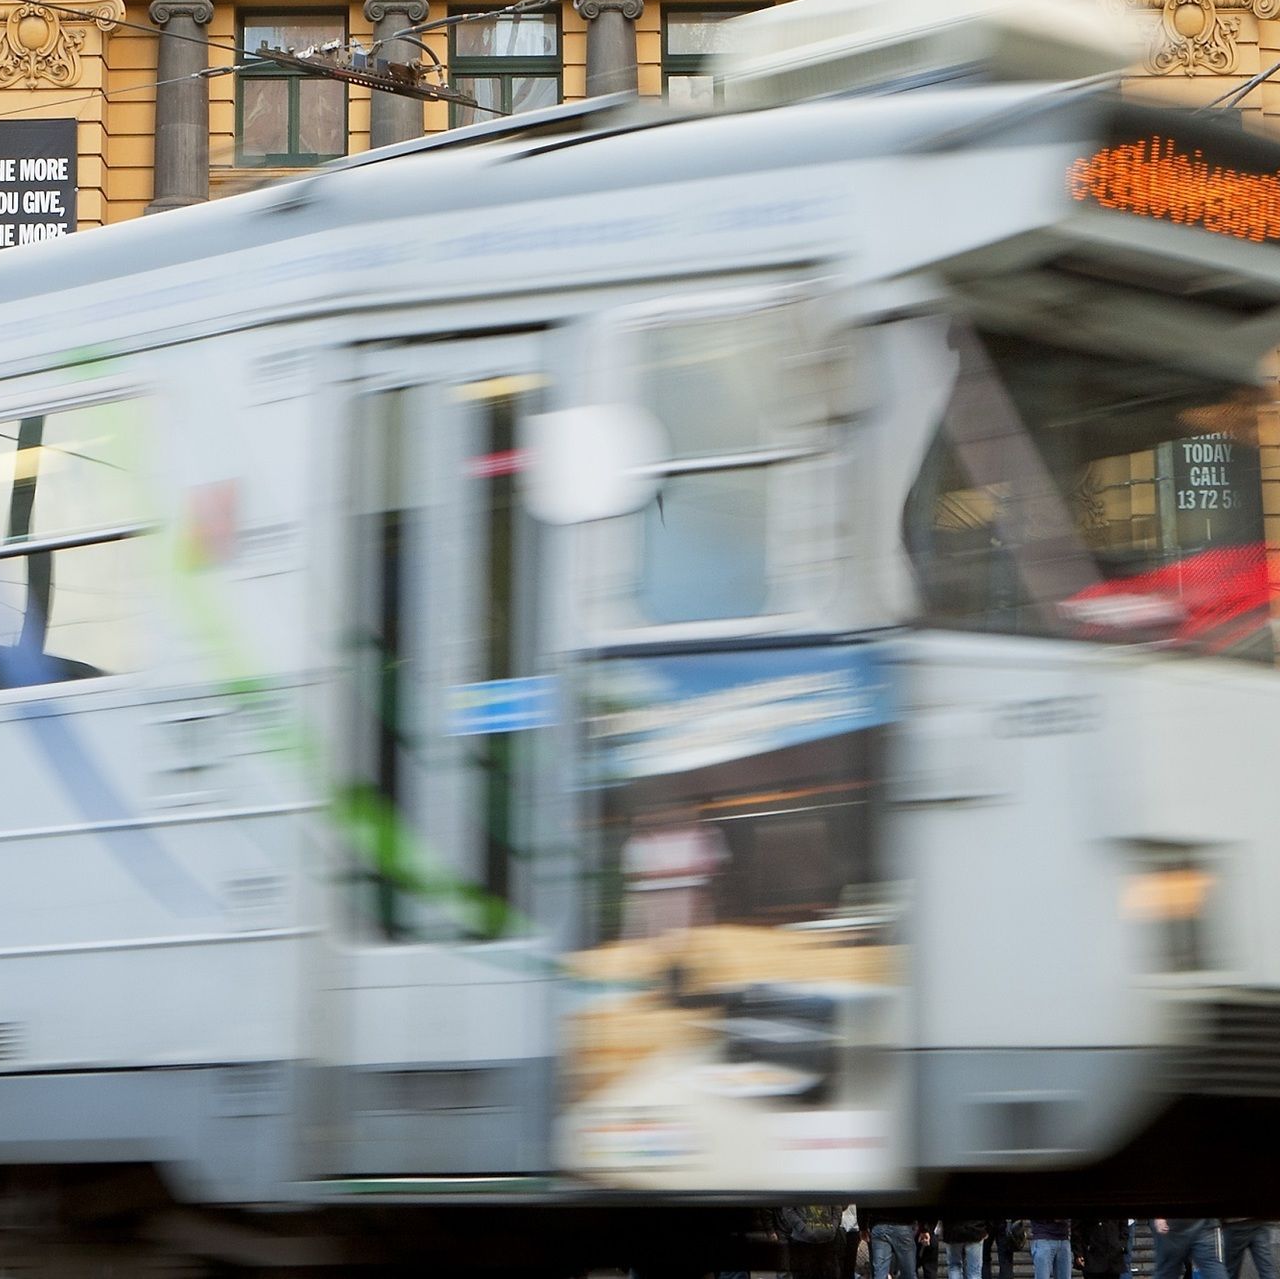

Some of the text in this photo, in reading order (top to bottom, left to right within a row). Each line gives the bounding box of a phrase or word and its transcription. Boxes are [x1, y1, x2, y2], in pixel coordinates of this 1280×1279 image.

[20, 158, 69, 182] MORE
[22, 190, 66, 217] GIVE,
[1190, 466, 1230, 487] CALL
[1177, 489, 1196, 510] 13
[1199, 489, 1218, 510] 72
